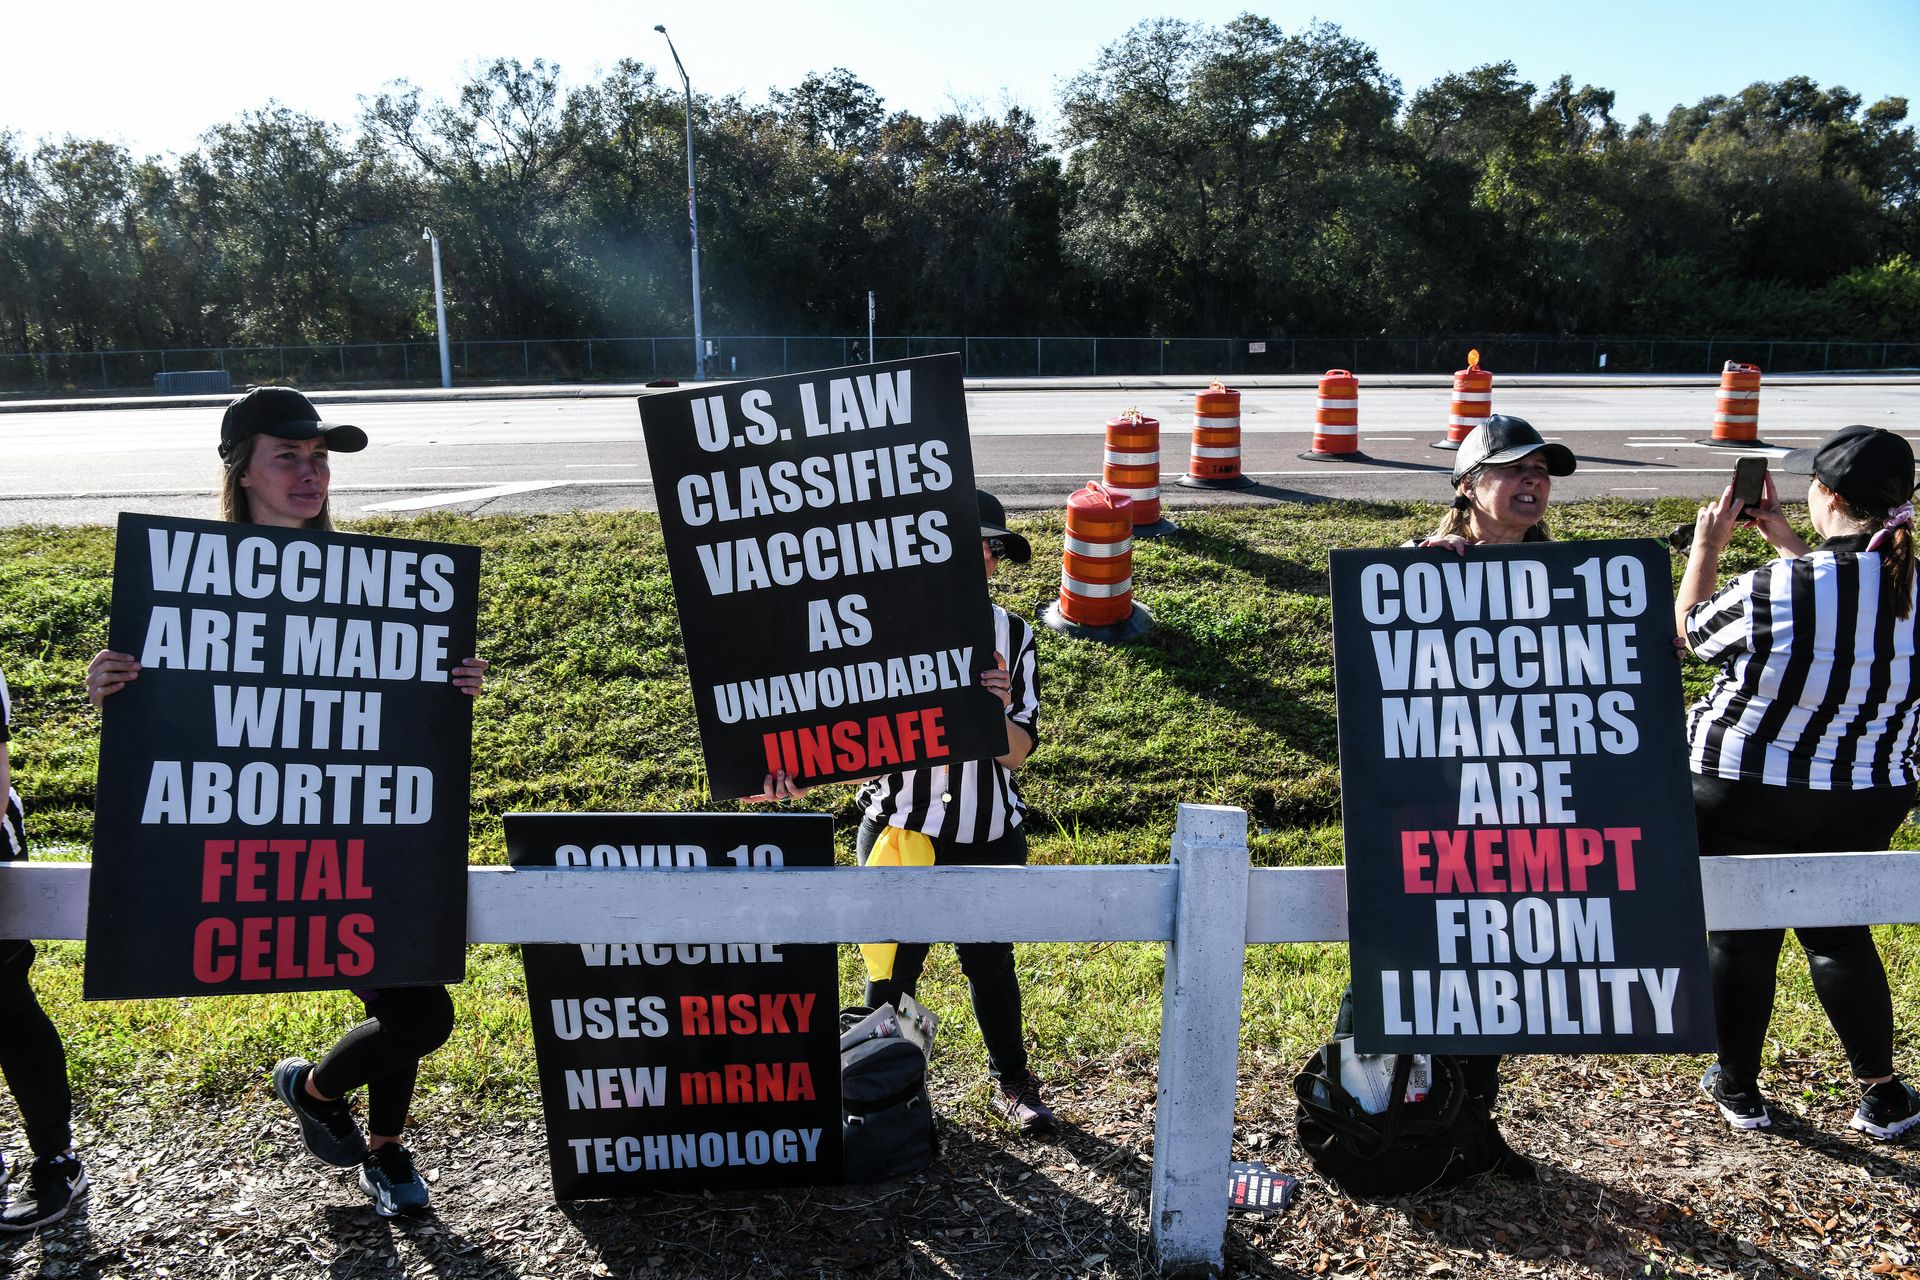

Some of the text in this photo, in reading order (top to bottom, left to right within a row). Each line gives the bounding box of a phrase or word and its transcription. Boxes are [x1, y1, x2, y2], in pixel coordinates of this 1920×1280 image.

[690, 369, 912, 452] U.S. LAW
[677, 439, 953, 527] CLASSIFIES
[148, 528, 455, 613] VACCINES
[695, 510, 953, 596] VACCINES
[808, 594, 873, 652] AS
[1361, 555, 1647, 624] COVID-19
[140, 606, 450, 683] ARE MADE
[1371, 623, 1642, 690] VACCINE
[213, 685, 382, 751] WITH
[713, 646, 973, 723] UNAVOIDABLY
[763, 707, 949, 779] UNSAFE
[1381, 690, 1639, 758] MAKERS
[140, 761, 434, 826] ABORTED
[1457, 760, 1577, 825] ARE
[201, 839, 373, 903] FETAL
[555, 844, 784, 866] COVID19
[1401, 827, 1642, 893] EXEMPT
[193, 914, 375, 984] CELLS
[1435, 896, 1615, 964] FROM
[551, 993, 816, 1041] USES RISKY
[1381, 967, 1681, 1035] LIABILITY
[565, 1062, 816, 1110] NEW mRNA
[568, 1128, 822, 1174] TECHNOLOGY
